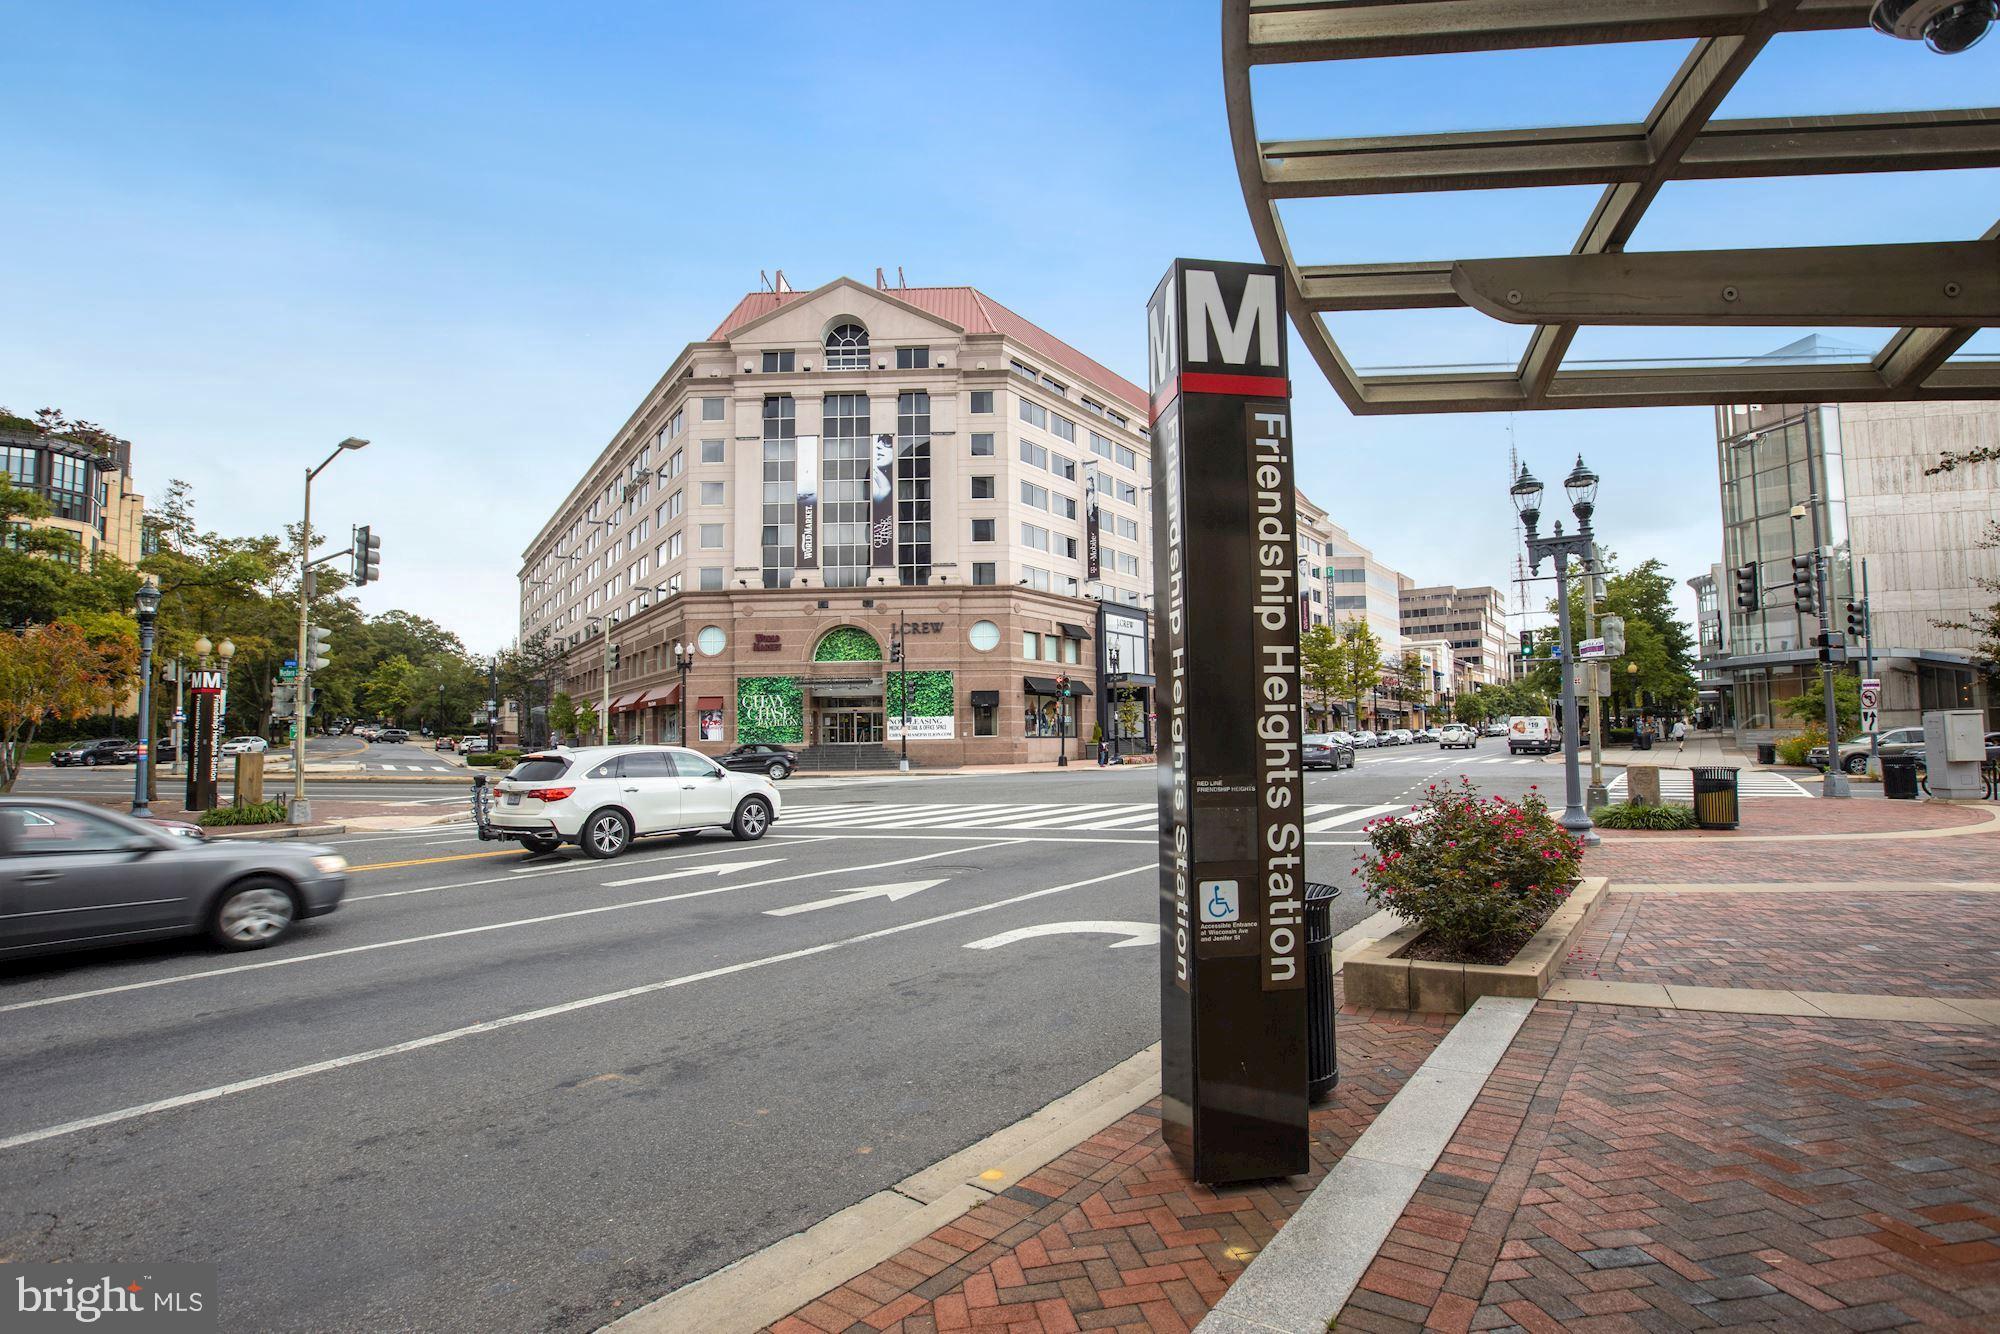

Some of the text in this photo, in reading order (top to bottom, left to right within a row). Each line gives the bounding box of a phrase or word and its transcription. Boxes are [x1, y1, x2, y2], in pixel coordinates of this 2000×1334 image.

[1150, 275, 1176, 397] M
[1185, 269, 1280, 367] M
[804, 534, 813, 559] WORLD
[203, 671, 221, 689] M
[741, 694, 783, 708] CHEVY
[1166, 412, 1190, 981] Friendship Heights Station
[1253, 412, 1302, 982] Friendship Heights Station
[747, 707, 792, 720] CHASE
